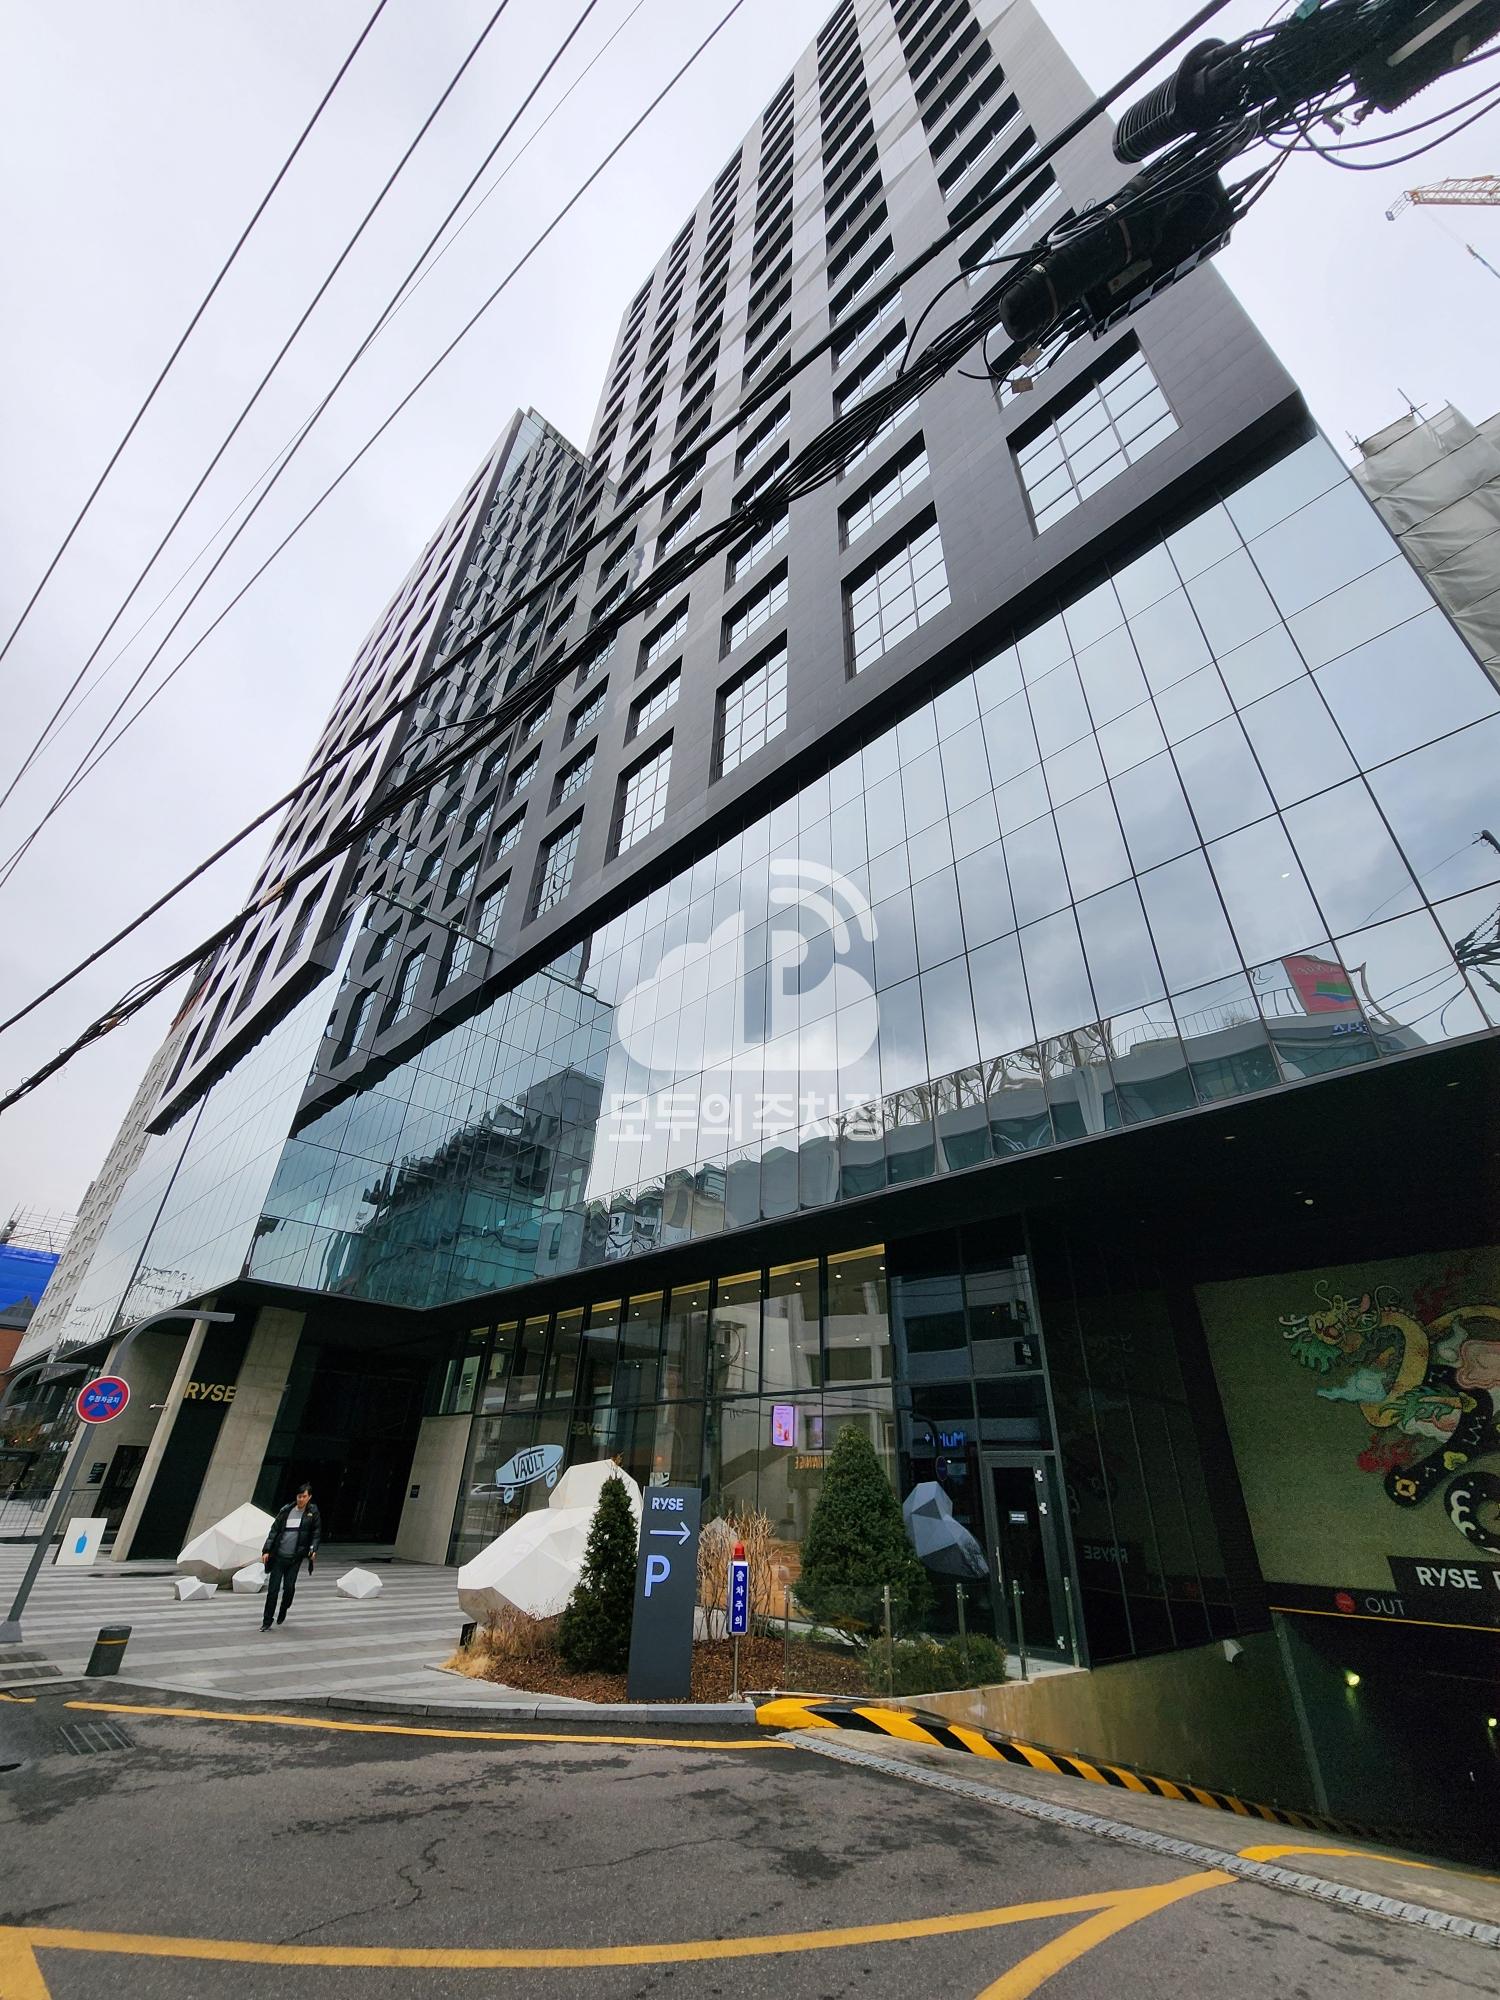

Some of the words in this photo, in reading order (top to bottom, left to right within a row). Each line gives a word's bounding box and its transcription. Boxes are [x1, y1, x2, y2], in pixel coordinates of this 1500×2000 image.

[184, 1382, 237, 1403] RYSE
[512, 1448, 545, 1480] VAULT
[651, 1497, 684, 1511] RYSE
[644, 1554, 671, 1597] P
[1415, 1566, 1483, 1590] RYSE
[734, 1570, 745, 1627] 출차주의
[1365, 1596, 1406, 1617] OUT
